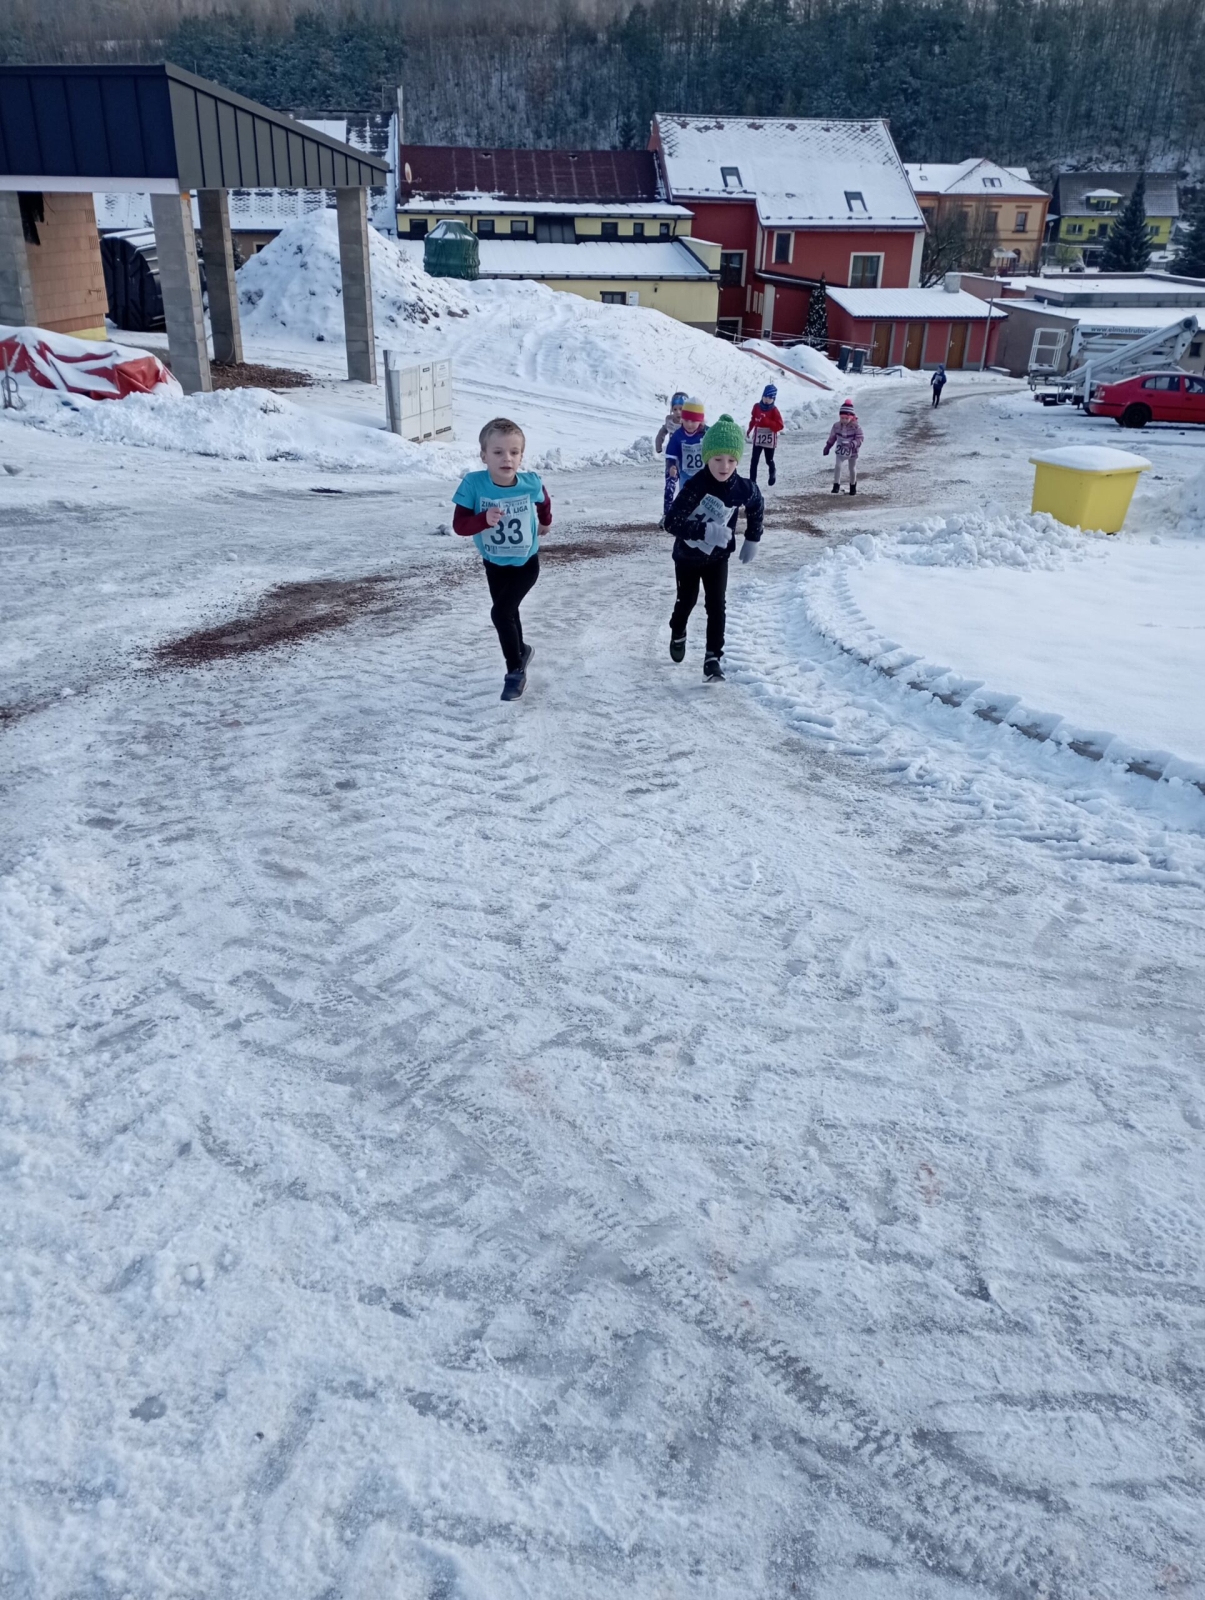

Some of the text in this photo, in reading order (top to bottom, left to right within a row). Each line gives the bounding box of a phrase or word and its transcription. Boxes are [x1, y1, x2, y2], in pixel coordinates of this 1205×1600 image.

[757, 433, 773, 444] 125
[835, 444, 851, 456] 209
[686, 453, 703, 469] 28
[513, 505, 528, 514] LIGA
[490, 518, 524, 545] 33
